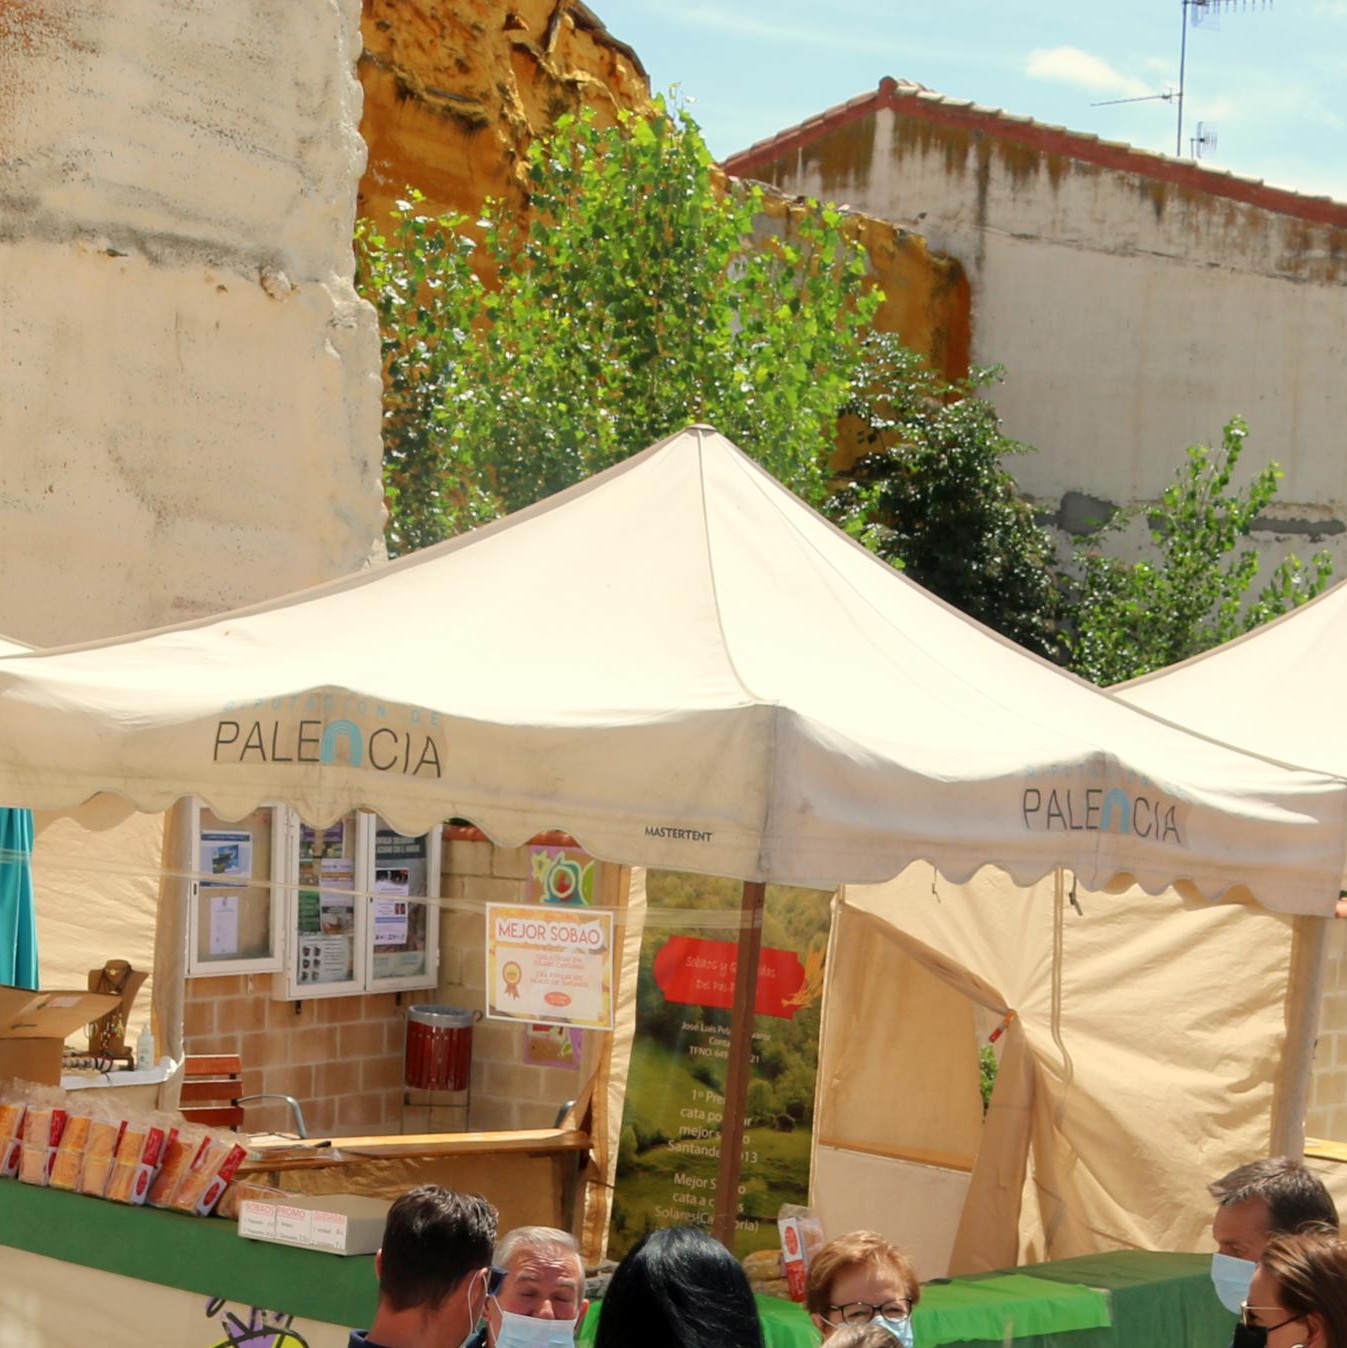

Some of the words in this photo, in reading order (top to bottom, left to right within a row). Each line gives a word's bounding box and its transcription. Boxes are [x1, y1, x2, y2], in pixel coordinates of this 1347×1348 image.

[213, 718, 442, 779] PALENCIA
[1023, 786, 1182, 844] PALENCIA
[644, 825, 713, 843] MASTERTENT
[497, 922, 546, 941] MEJOR
[550, 924, 601, 945] SOBAO
[680, 1107, 706, 1120] cata
[678, 1125, 714, 1140] mejor
[667, 1140, 722, 1159] Santande
[673, 1172, 708, 1190] Mejor
[672, 1193, 701, 1207] cata
